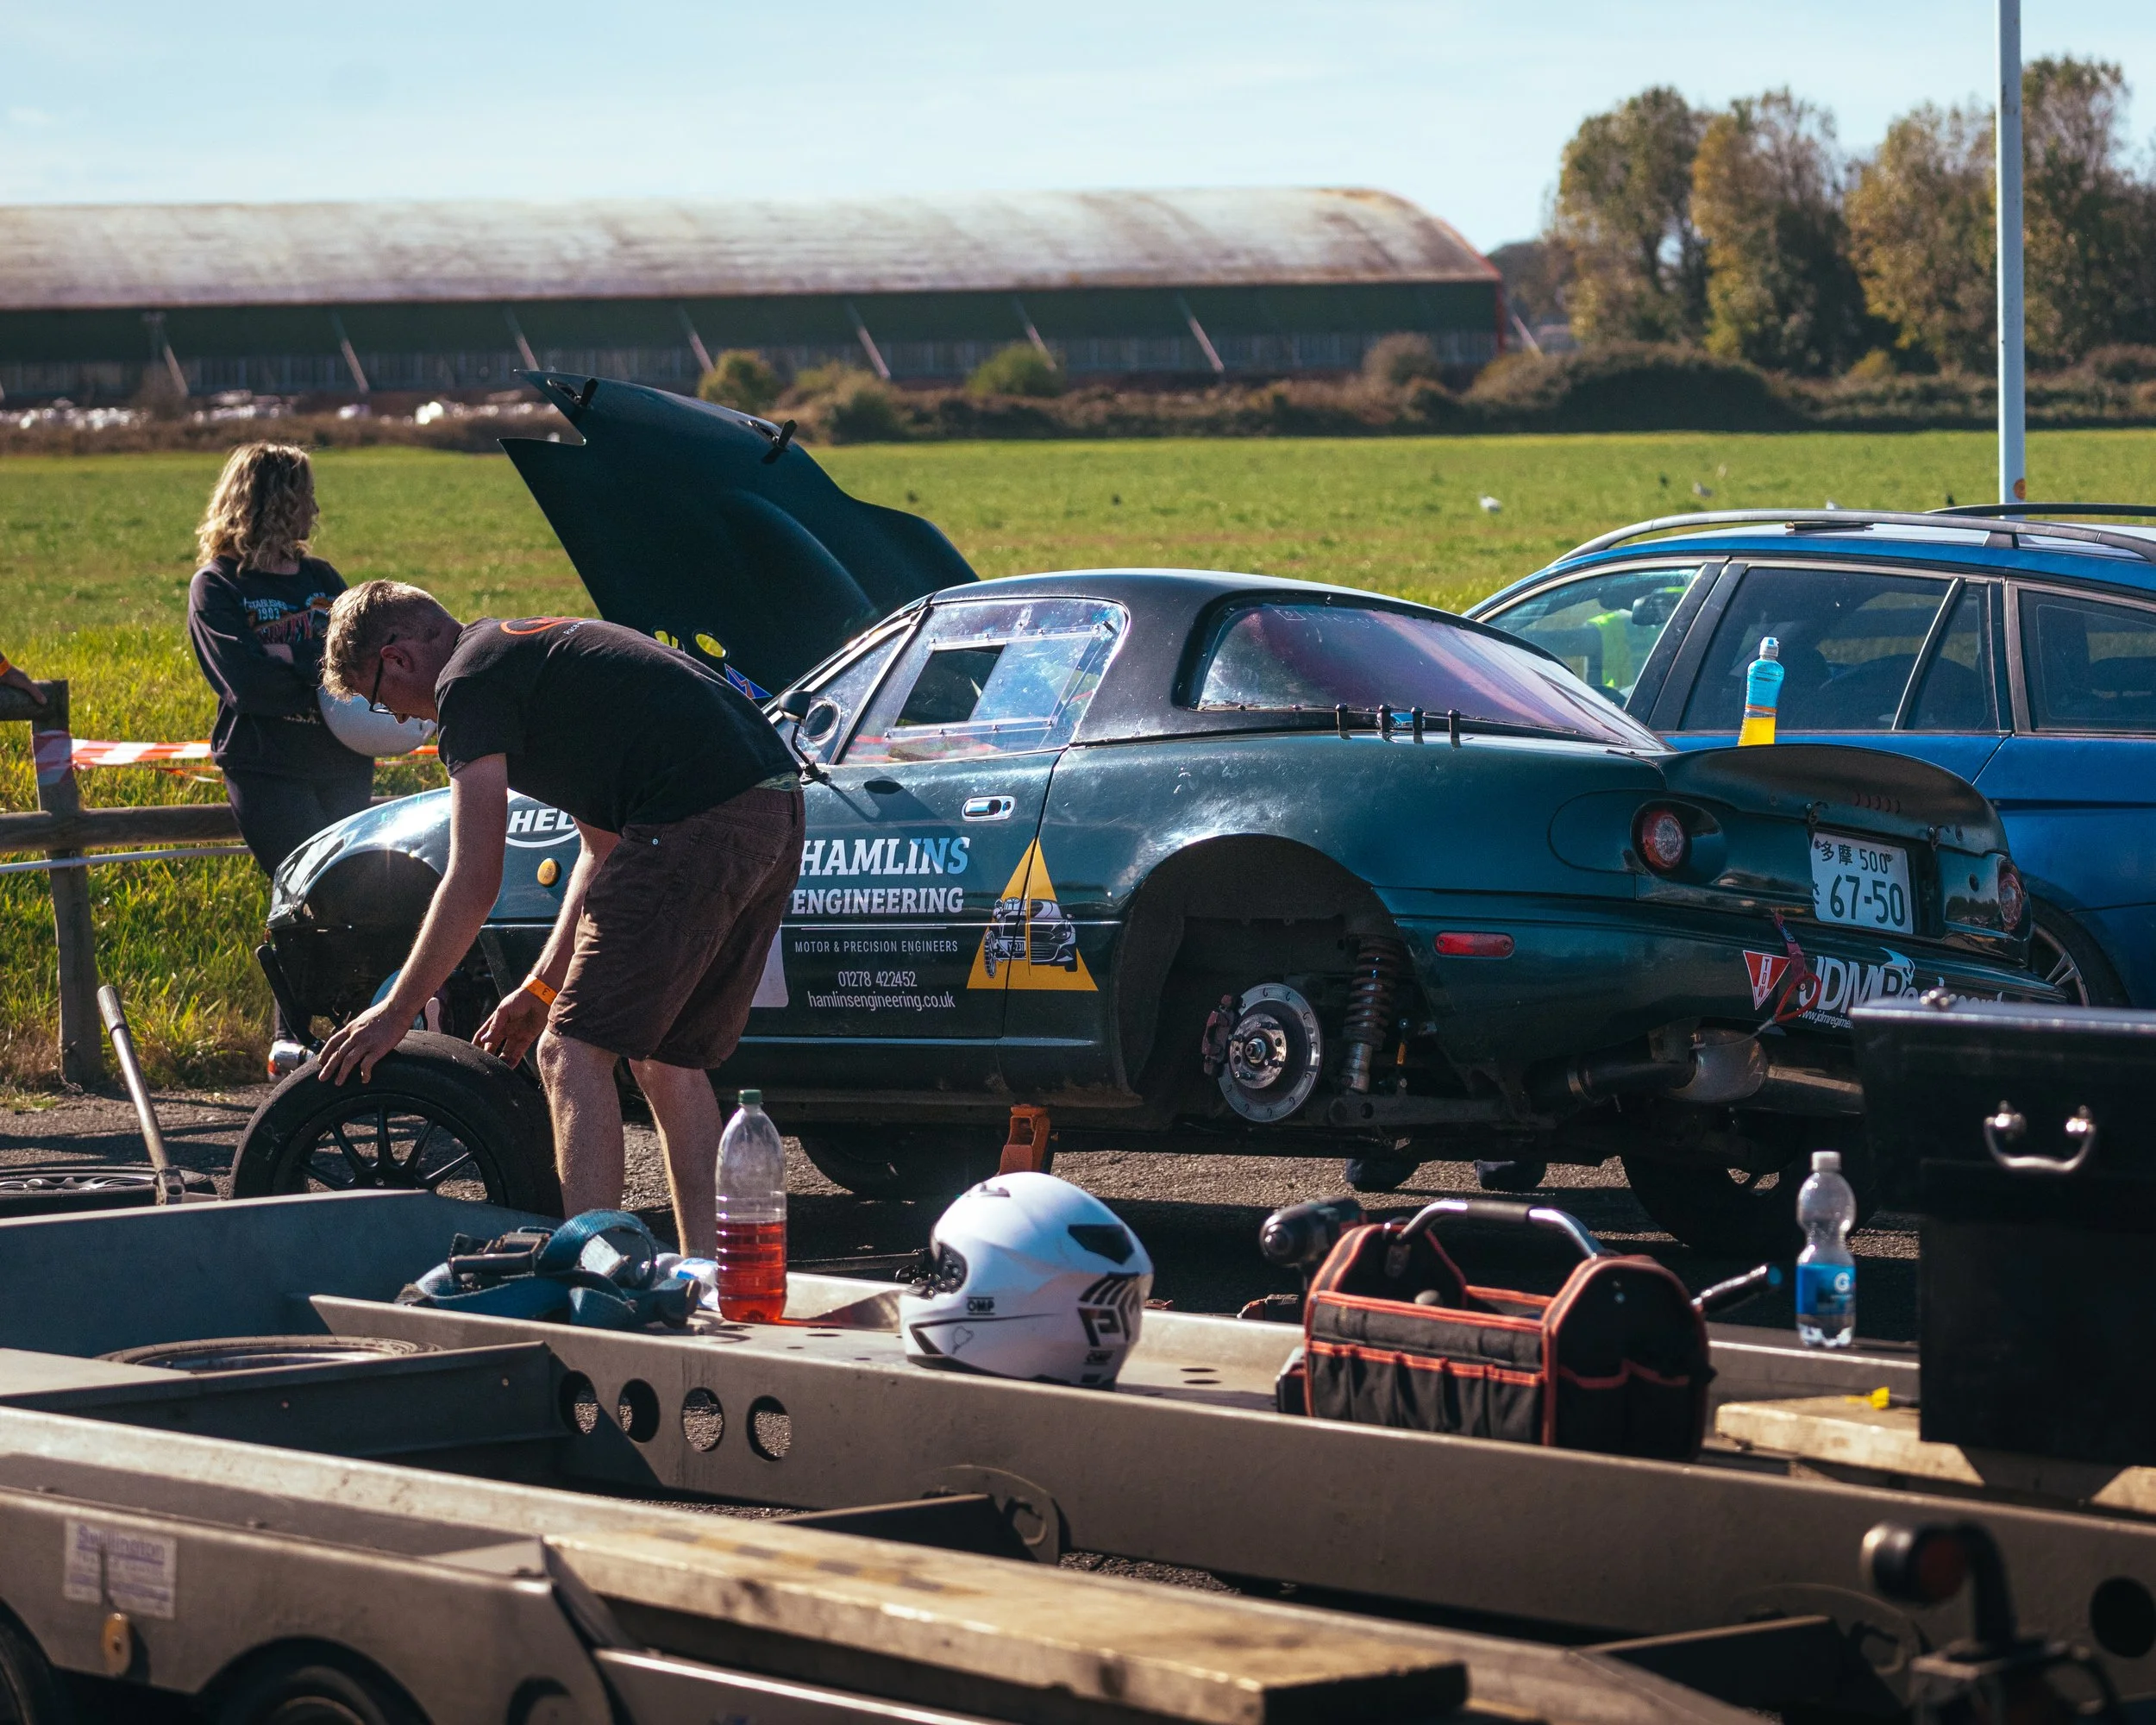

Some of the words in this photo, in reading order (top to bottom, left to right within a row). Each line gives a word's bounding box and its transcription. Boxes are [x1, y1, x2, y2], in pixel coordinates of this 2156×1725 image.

[258, 607, 280, 620] 1903
[800, 837, 971, 876] HAMLINS
[1859, 849, 1889, 874] 500
[791, 888, 964, 914] ENGINEERING
[1830, 875, 1905, 927] 67-50
[795, 941, 830, 952] MOTOR
[834, 942, 840, 952] &
[843, 941, 897, 952] PRECISION
[901, 941, 958, 952] ENGINEERS
[837, 971, 872, 987] 01278
[875, 971, 918, 987] 422452
[1758, 958, 1770, 998] TOW
[807, 991, 956, 1012] hamlinsengineering.co.uk
